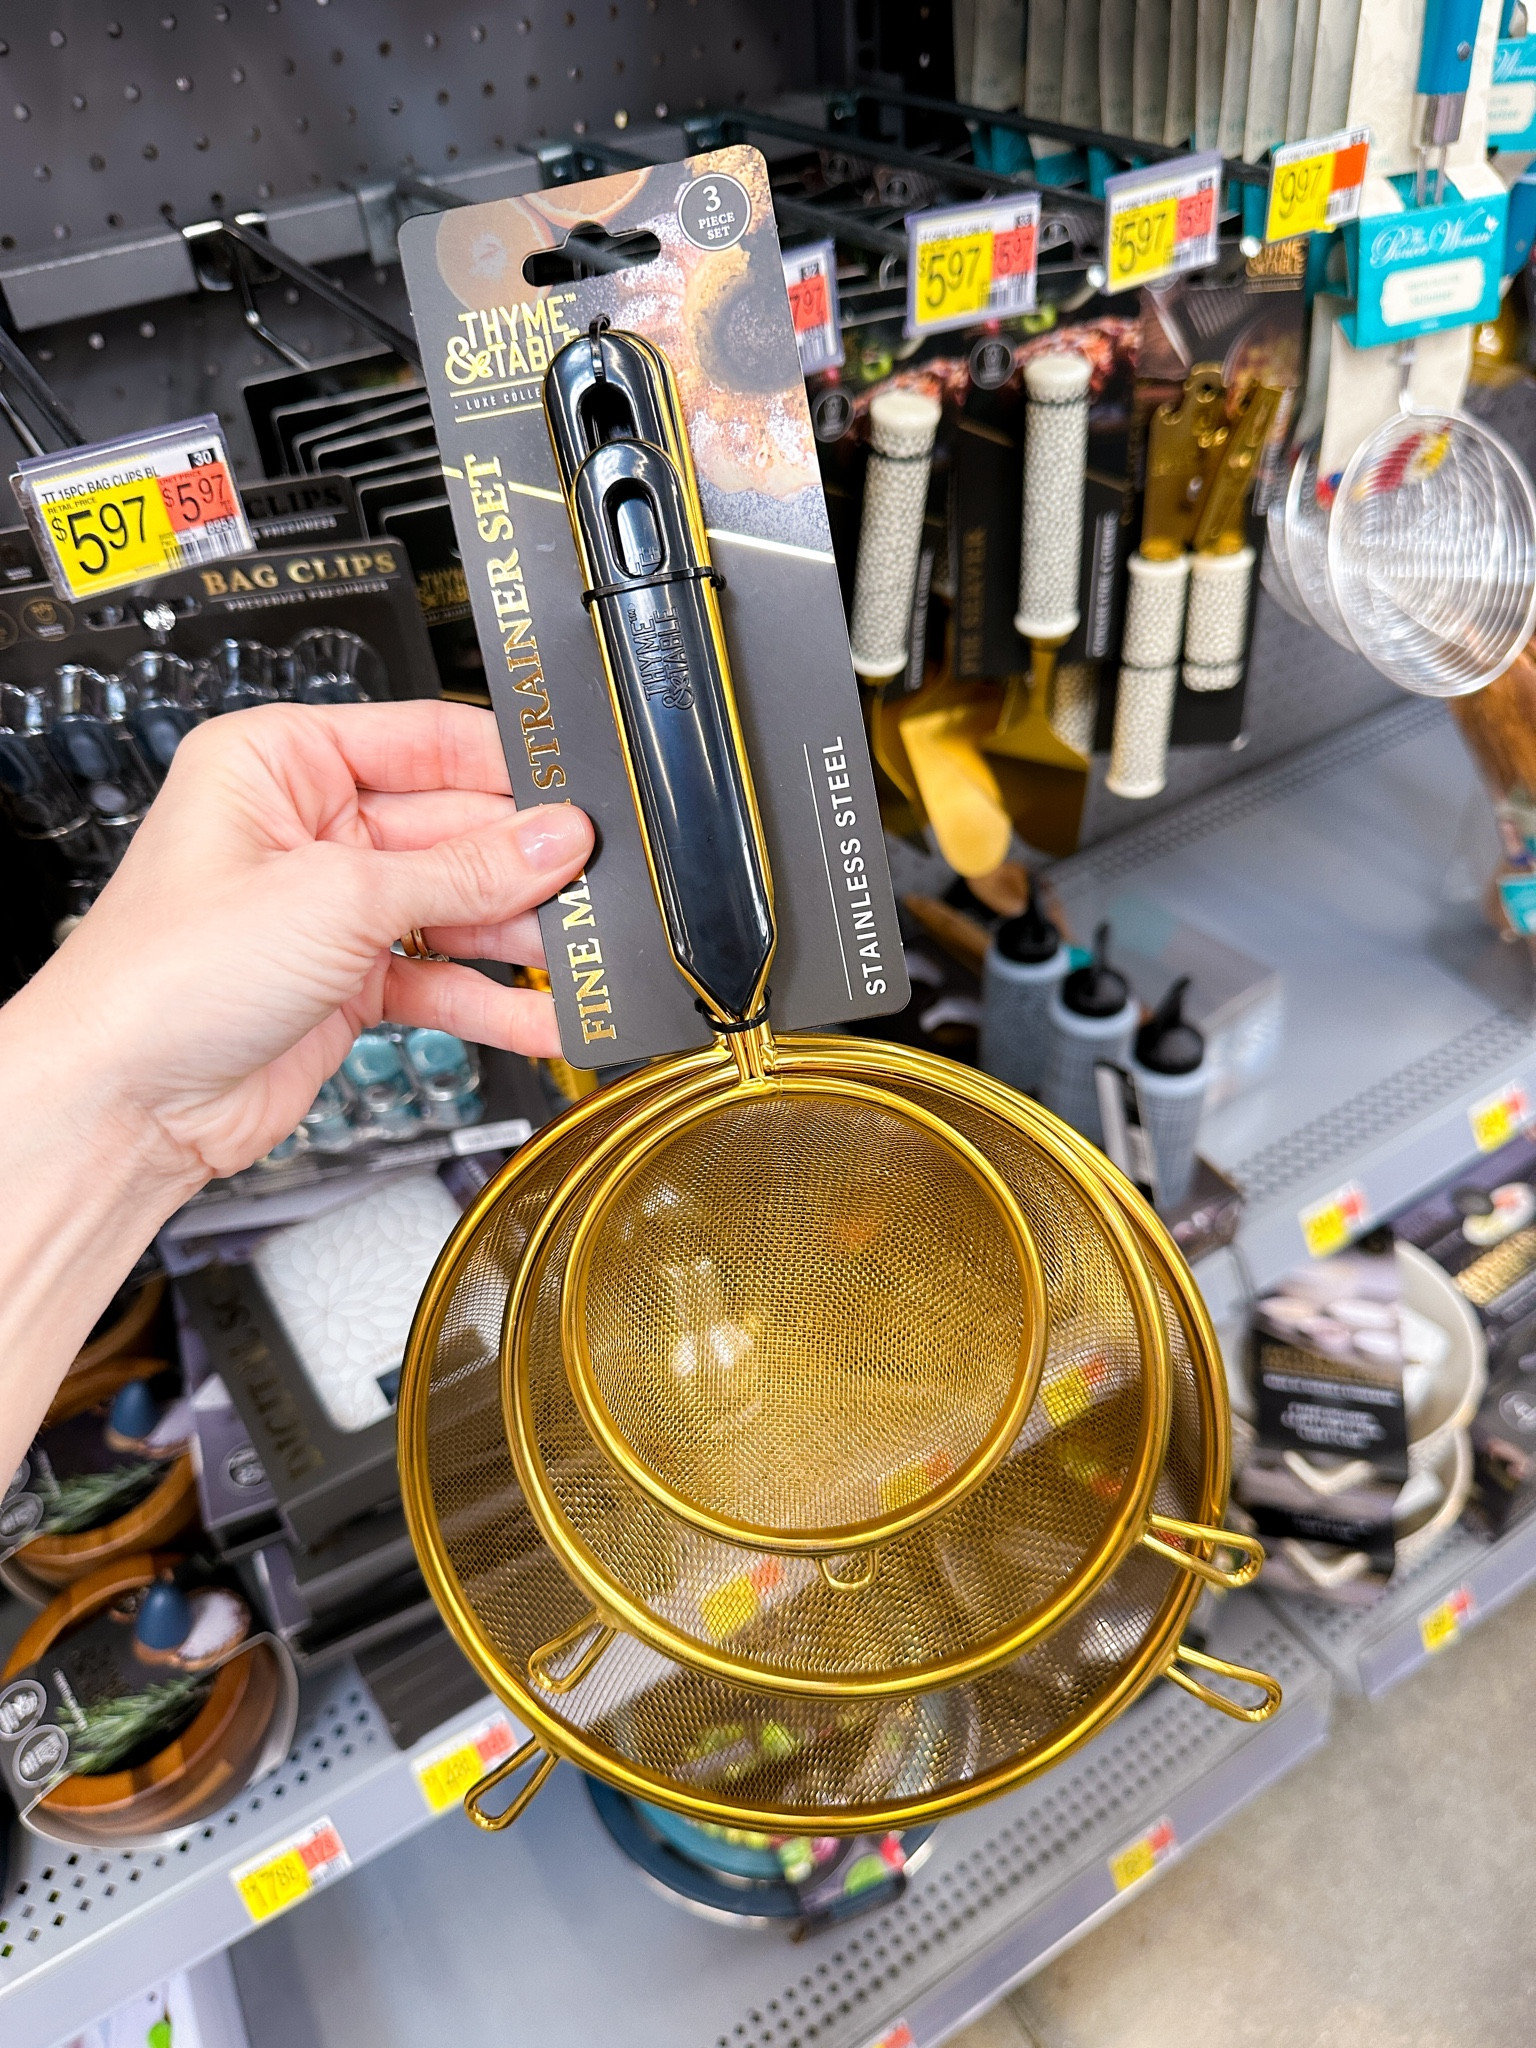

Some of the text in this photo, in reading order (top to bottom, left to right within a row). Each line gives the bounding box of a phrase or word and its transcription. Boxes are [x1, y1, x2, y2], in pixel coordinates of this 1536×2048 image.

[698, 212, 735, 230] PIECE
[702, 185, 722, 212] 3
[707, 225, 730, 241] SET
[1111, 211, 1169, 273] $597
[918, 246, 981, 308] $597
[466, 387, 541, 411] LUXE COLLE
[193, 449, 214, 468] 30
[41, 466, 161, 506] TT 15PC BAG CLIPS BL
[46, 497, 98, 515] RETAIL PRICE
[162, 473, 225, 523] $597
[463, 453, 514, 543] SET
[50, 495, 147, 576] $597
[201, 550, 397, 597] BAG CLIPS
[486, 547, 567, 790] STRAINER
[822, 735, 888, 996] STAINLESS STEEL
[566, 938, 618, 1045] FINE
